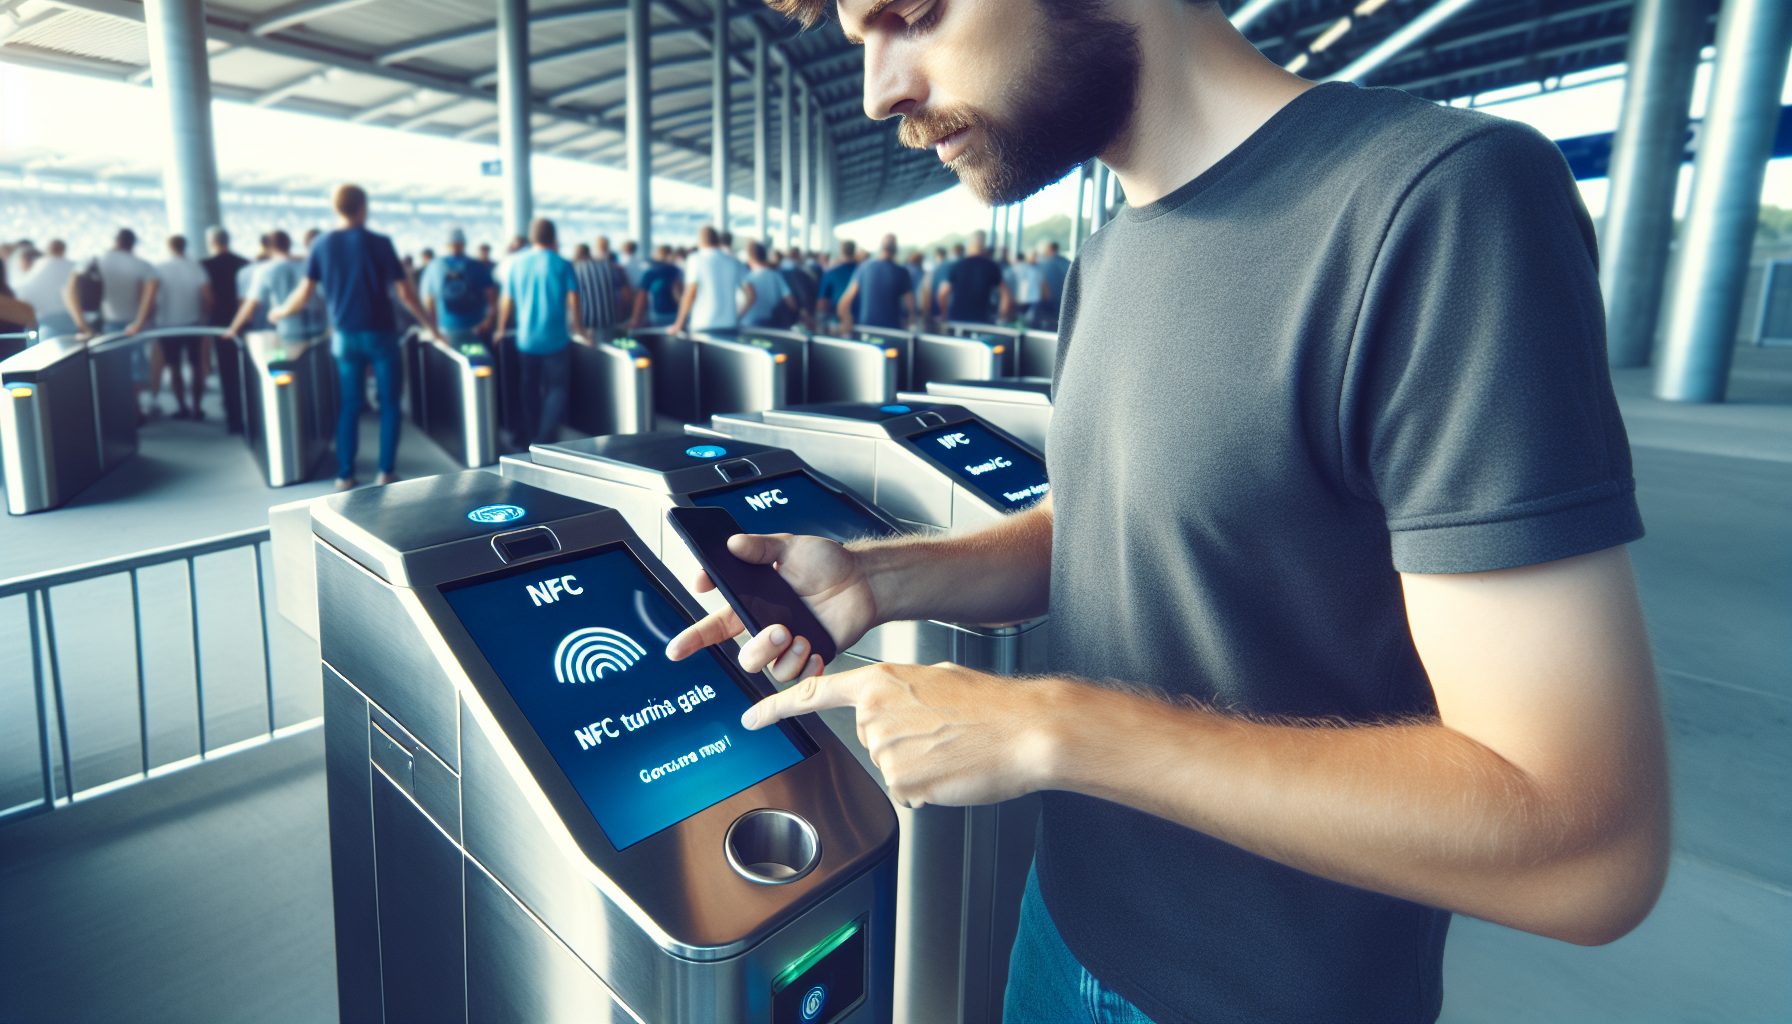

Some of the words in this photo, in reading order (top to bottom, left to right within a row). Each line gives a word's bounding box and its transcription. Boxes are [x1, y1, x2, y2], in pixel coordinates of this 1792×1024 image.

[744, 488, 789, 511] NFC
[526, 575, 584, 607] NFC
[573, 717, 620, 750] NFC
[677, 684, 716, 713] gate
